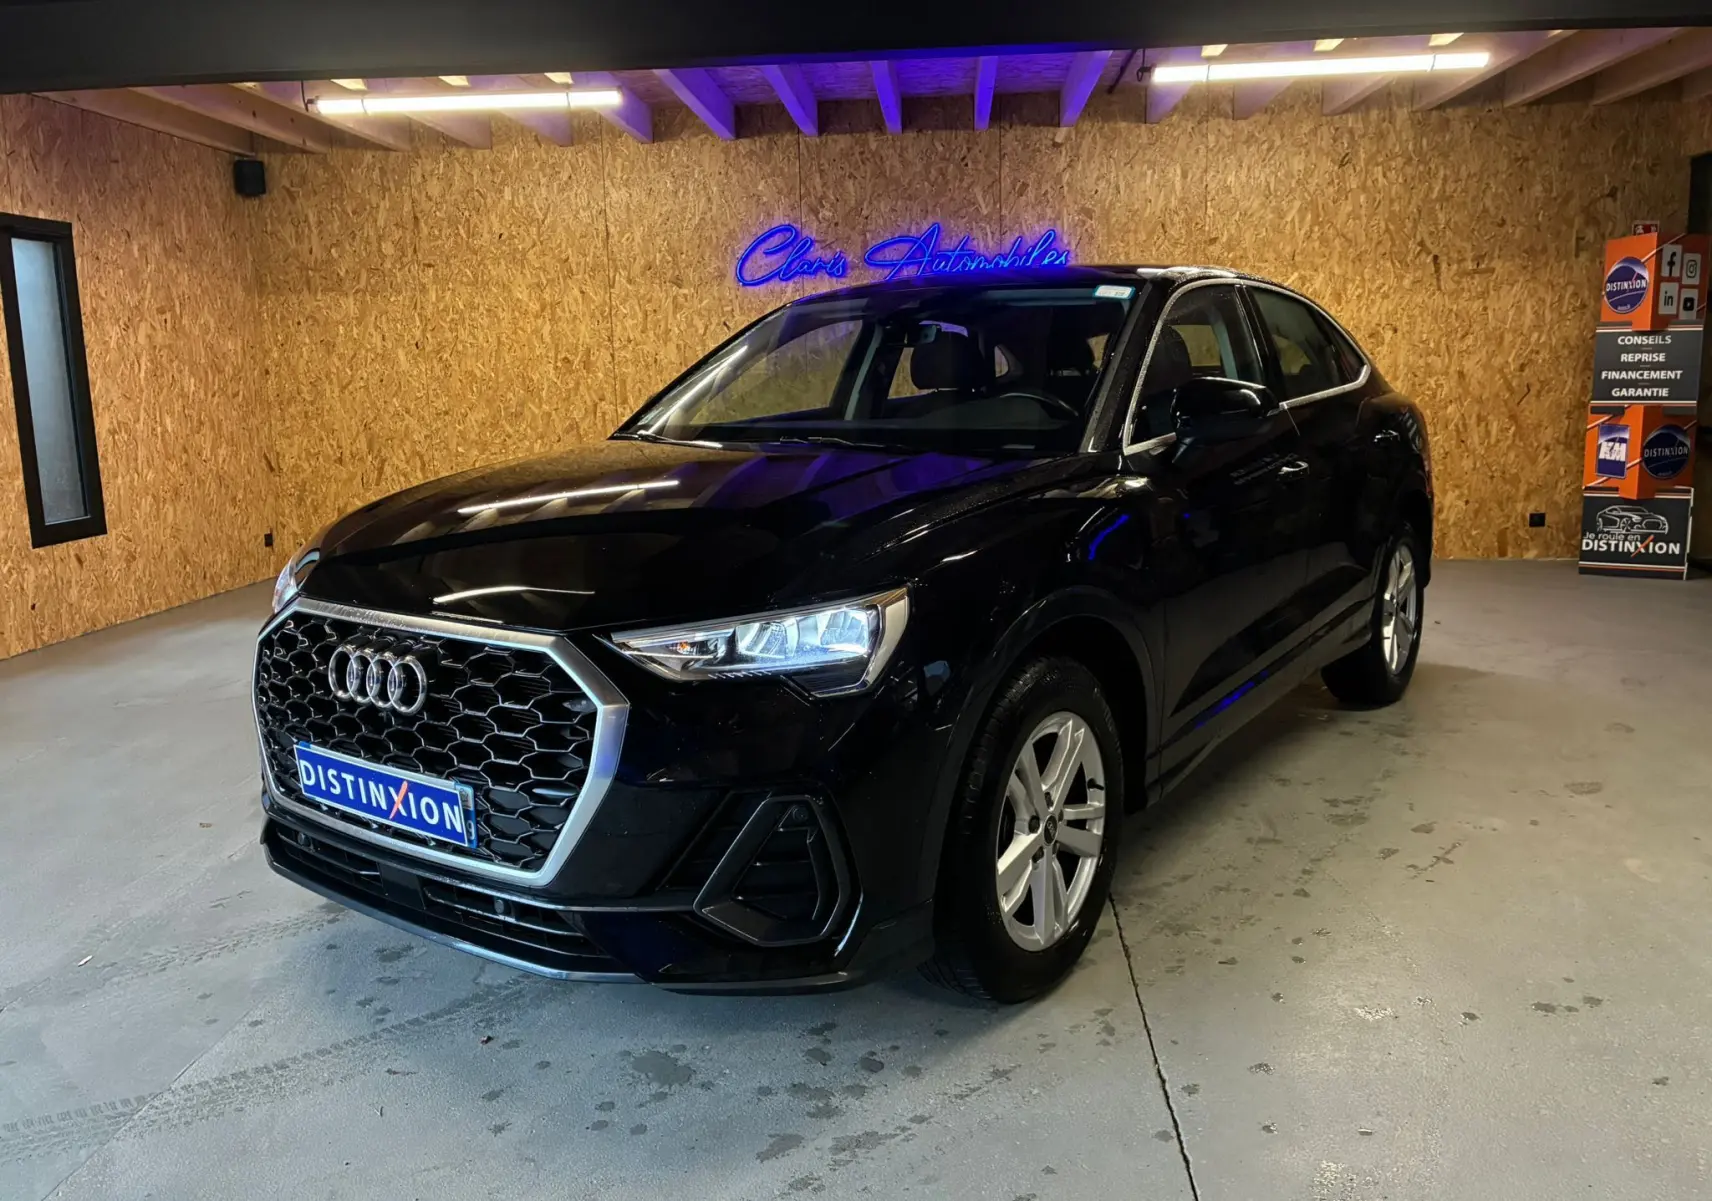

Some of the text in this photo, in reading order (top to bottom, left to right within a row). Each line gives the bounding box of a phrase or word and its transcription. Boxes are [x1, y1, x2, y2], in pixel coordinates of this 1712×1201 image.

[864, 222, 1069, 280] Automobiles
[1605, 278, 1647, 292] DISTINXION
[1663, 291, 1674, 307] in
[1617, 335, 1672, 345] CONSEILS
[1620, 353, 1666, 362] REPRISE
[1601, 370, 1683, 380] FINANCEMENT
[1611, 388, 1670, 397] GARANTIE
[1644, 446, 1688, 457] DISTINXION
[1583, 532, 1595, 540] Je
[1598, 532, 1624, 541] roule
[1581, 537, 1681, 556] DISTINXION
[300, 760, 463, 833] DISTINXION
